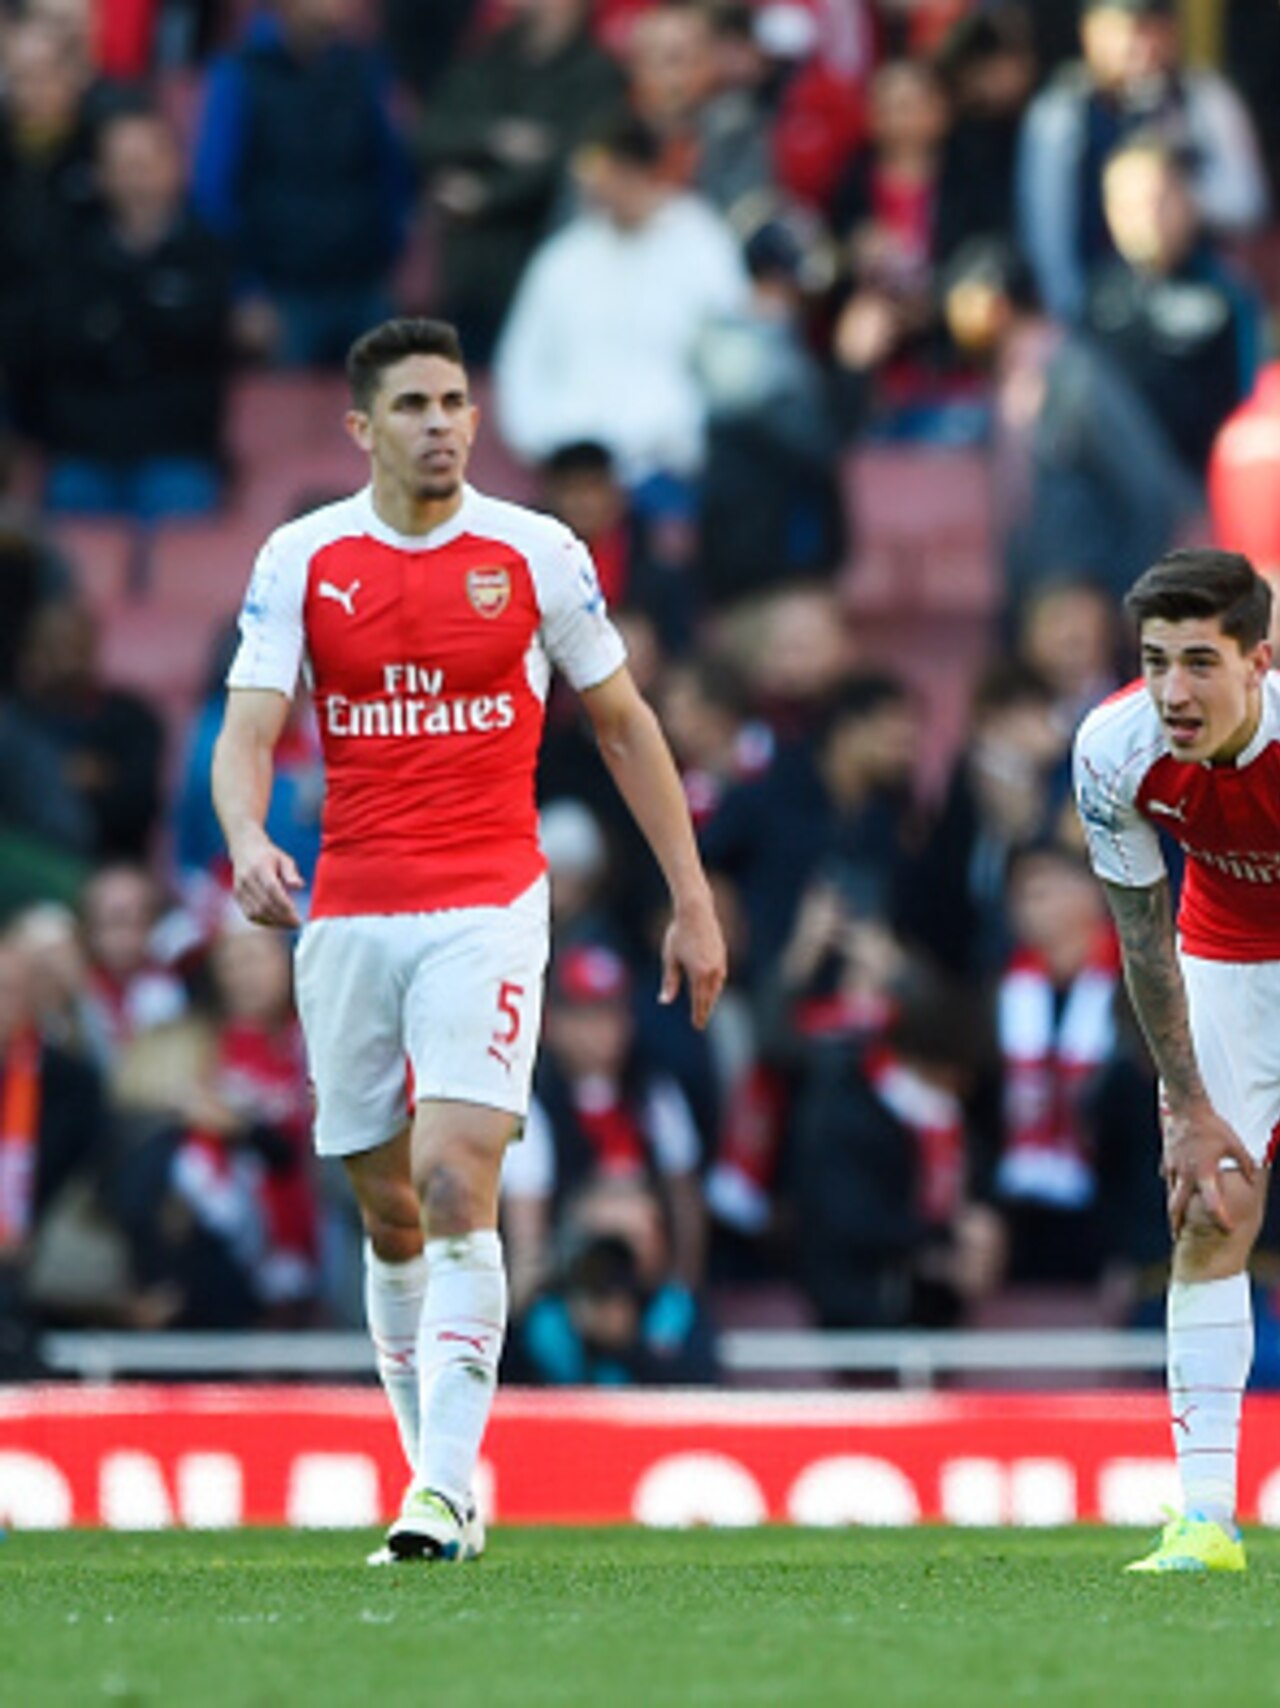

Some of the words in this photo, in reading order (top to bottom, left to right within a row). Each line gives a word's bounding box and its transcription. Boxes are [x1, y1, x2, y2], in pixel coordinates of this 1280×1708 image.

[383, 663, 443, 696] Fly
[327, 692, 515, 736] Emirates
[492, 980, 524, 1046] 5
